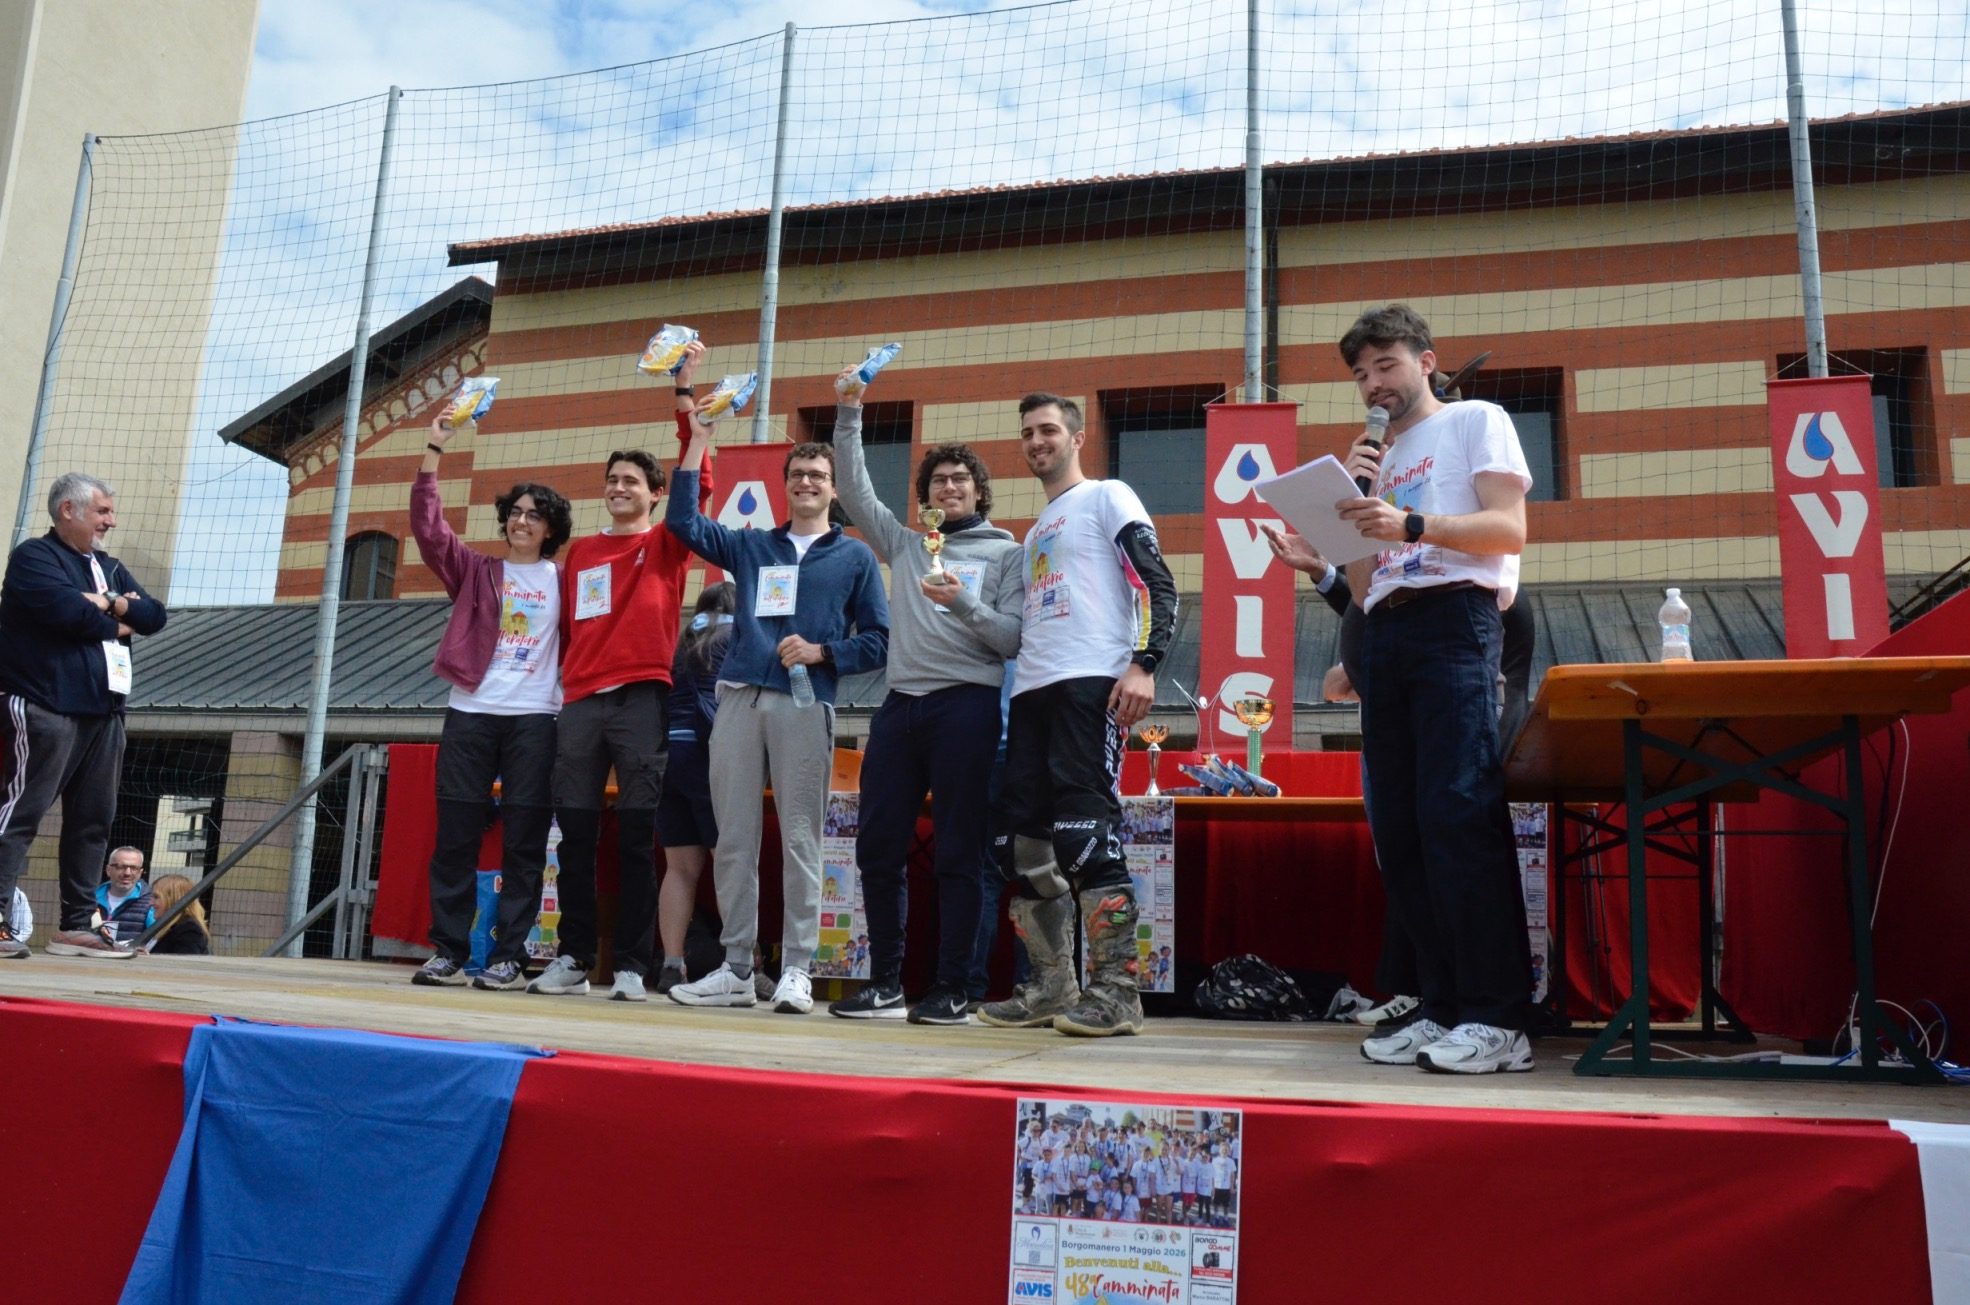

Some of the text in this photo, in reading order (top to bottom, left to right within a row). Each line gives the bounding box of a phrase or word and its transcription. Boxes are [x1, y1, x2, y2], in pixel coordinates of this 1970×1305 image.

[1785, 411, 1869, 641] AVI
[1214, 444, 1286, 737] AVIS
[1061, 1240, 1121, 1253] Borgomanero
[1123, 1245, 1127, 1253] 1
[1129, 1245, 1161, 1256] Maggio
[1163, 1248, 1186, 1257] 2026
[1063, 1256, 1140, 1270] Benvenuti
[1015, 1281, 1052, 1298] AVIS
[1093, 1273, 1180, 1304] Camminata
